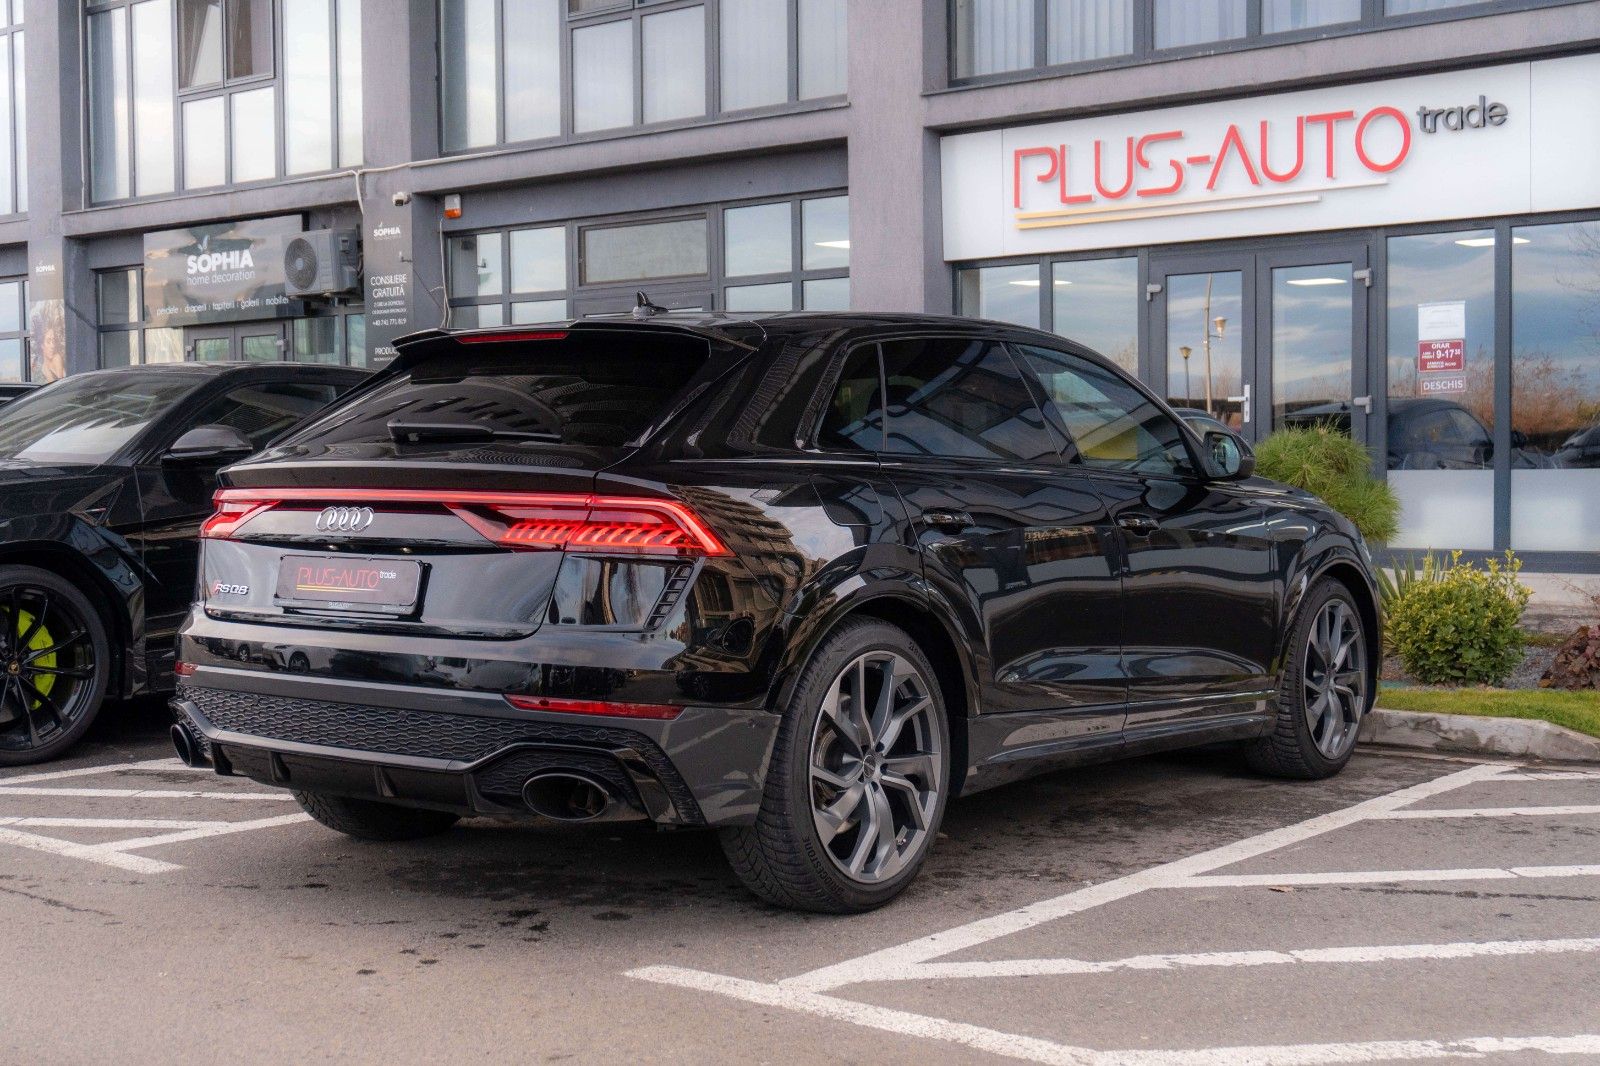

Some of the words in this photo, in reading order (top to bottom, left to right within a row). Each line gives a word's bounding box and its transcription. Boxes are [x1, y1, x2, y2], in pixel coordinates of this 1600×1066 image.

[1013, 105, 1412, 208] PLUS-AUTO
[1417, 95, 1508, 133] trade
[373, 226, 401, 237] SOPHIA
[187, 249, 254, 274] SOPHIA
[187, 274, 209, 286] home
[212, 270, 256, 284] decoration
[1431, 342, 1450, 350] ORAR
[1423, 380, 1463, 391] DESCHIS
[297, 566, 380, 588] PLUS-AUTO
[380, 569, 396, 579] trade
